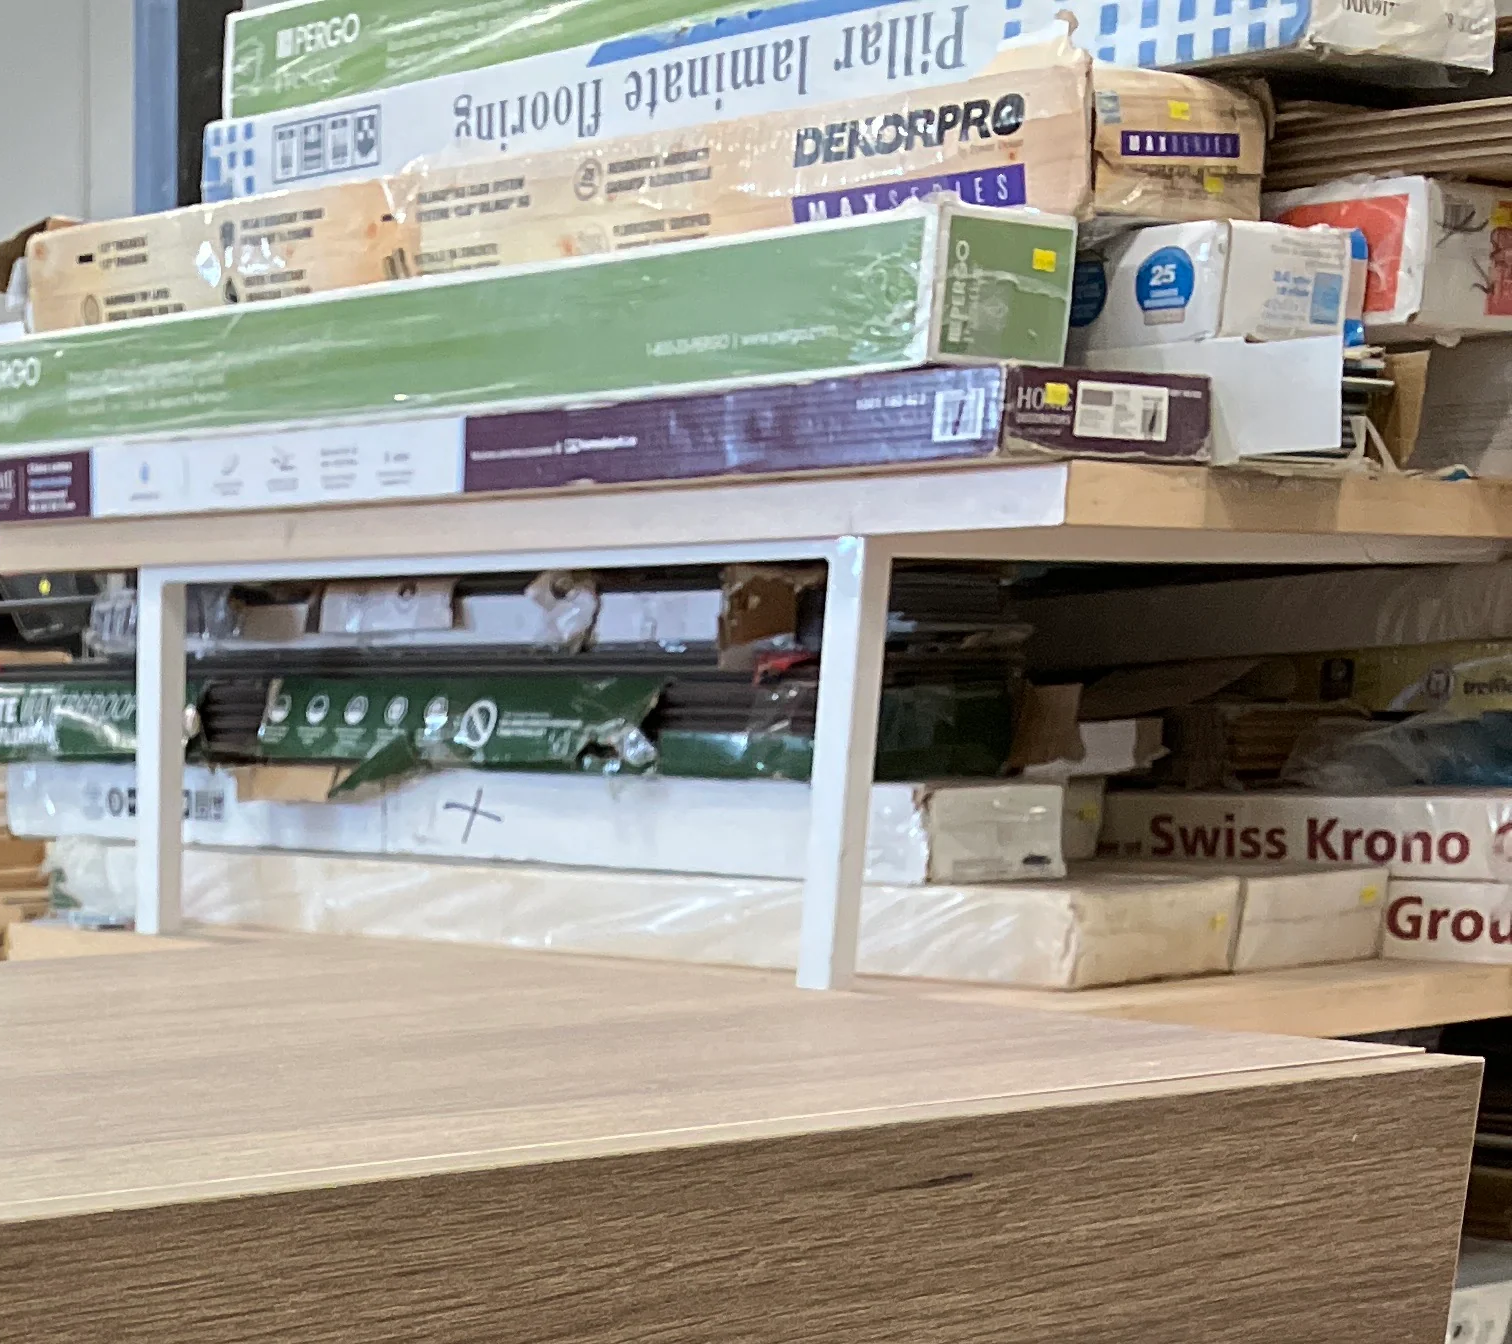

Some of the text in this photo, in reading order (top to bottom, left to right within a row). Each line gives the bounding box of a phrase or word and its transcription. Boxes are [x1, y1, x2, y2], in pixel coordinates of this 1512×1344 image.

[292, 13, 361, 53] PERGO
[833, 4, 968, 80] Pillar
[624, 34, 809, 119] laminate
[453, 77, 603, 152] flooring
[792, 92, 1026, 168] DEKORPRO
[1149, 813, 1288, 860] Swiss
[1306, 816, 1471, 865] Krono
